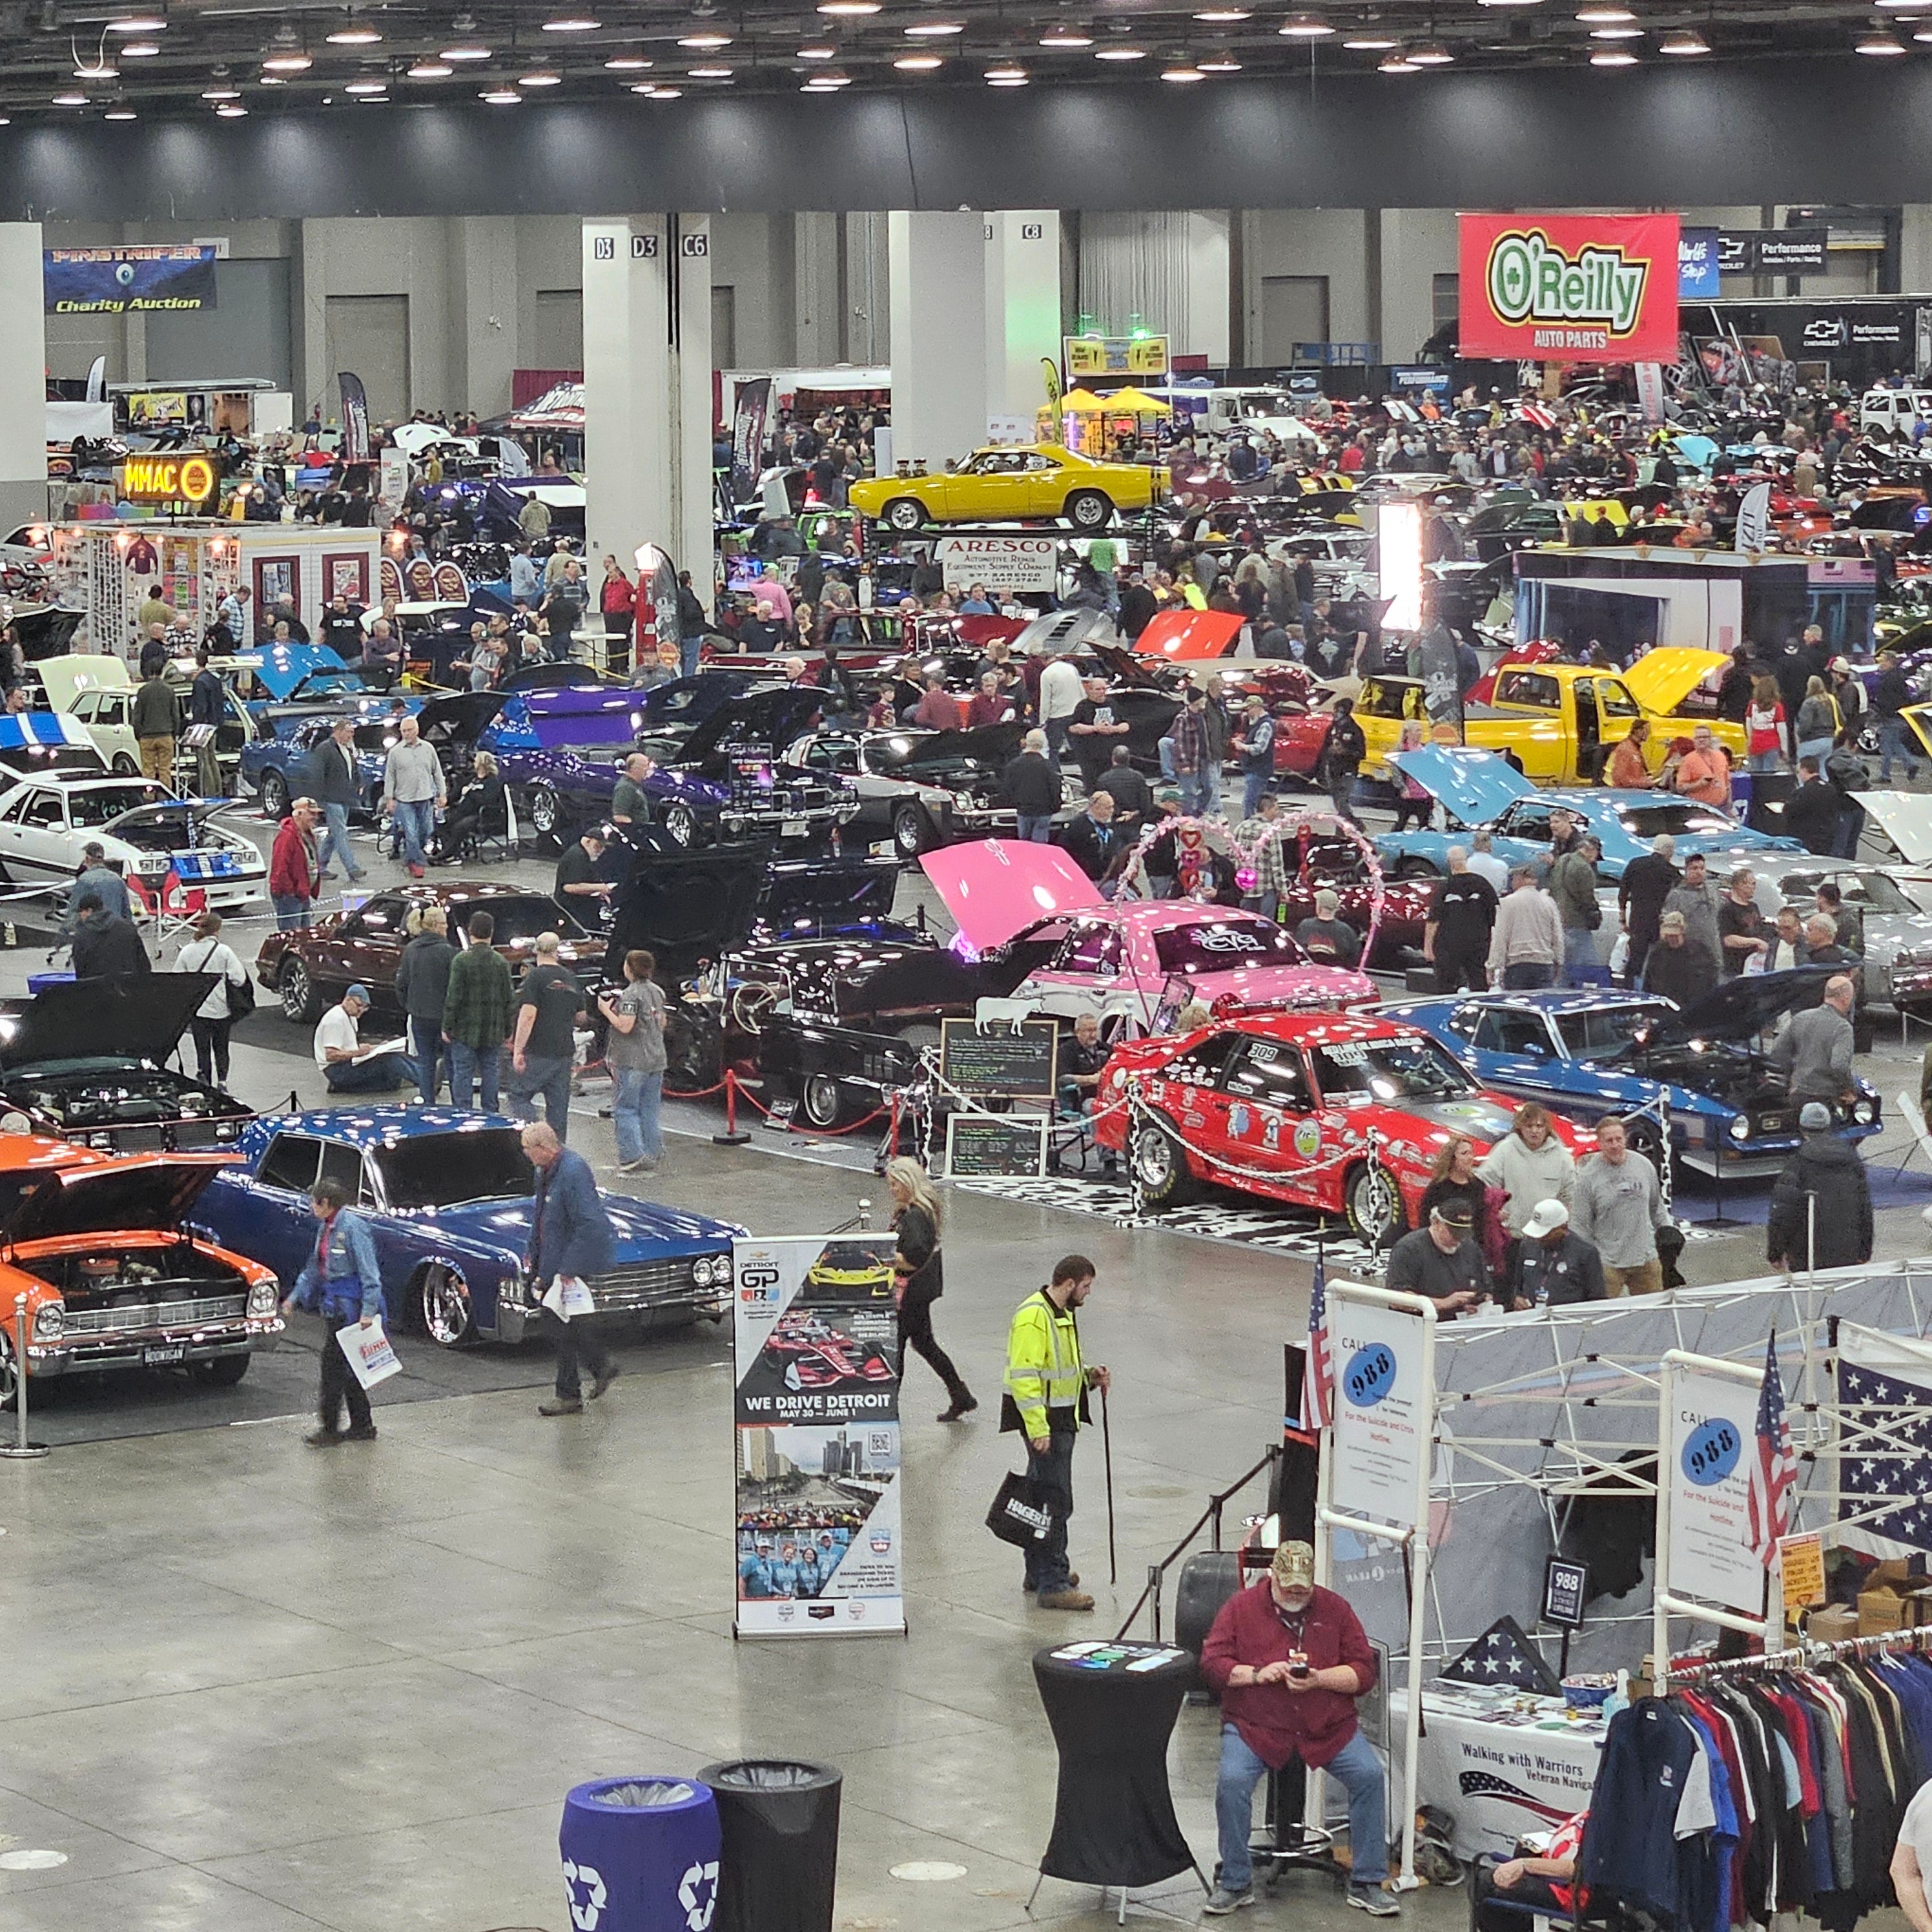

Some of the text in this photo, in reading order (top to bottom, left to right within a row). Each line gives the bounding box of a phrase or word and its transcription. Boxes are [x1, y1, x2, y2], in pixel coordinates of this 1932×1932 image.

[1025, 225, 1039, 238] C8
[52, 247, 201, 263] PINSTRIPER
[597, 238, 611, 259] D3
[633, 236, 655, 257] D3
[684, 236, 705, 256] C6
[1762, 243, 1822, 254] Performance
[1496, 243, 1637, 322] O'Reilly
[56, 297, 201, 313] Charity Auction
[1534, 329, 1607, 348] AUTO PARTS
[125, 464, 177, 493] MMAC
[947, 540, 1051, 553] ARESCO
[1249, 1044, 1276, 1060] 309
[741, 1269, 779, 1288] GP
[1342, 1337, 1368, 1352] CALL
[1351, 1352, 1390, 1397] 988
[746, 1394, 890, 1410] WE DRIVE DETROIT
[803, 1409, 814, 1417] 30
[825, 1409, 849, 1417] JUNE
[1345, 1411, 1355, 1420] For
[1356, 1414, 1366, 1423] the
[1368, 1415, 1388, 1428] Suicide
[1390, 1422, 1400, 1430] and
[1681, 1411, 1709, 1428] CALL
[1691, 1429, 1733, 1475] 988
[1683, 1490, 1694, 1499] For
[1696, 1493, 1706, 1503] the
[1708, 1495, 1731, 1508] Suicide
[1556, 1571, 1579, 1591] 988
[1462, 1742, 1583, 1776] Walking with Warriors
[1525, 1769, 1593, 1791] Veteran Naviga
